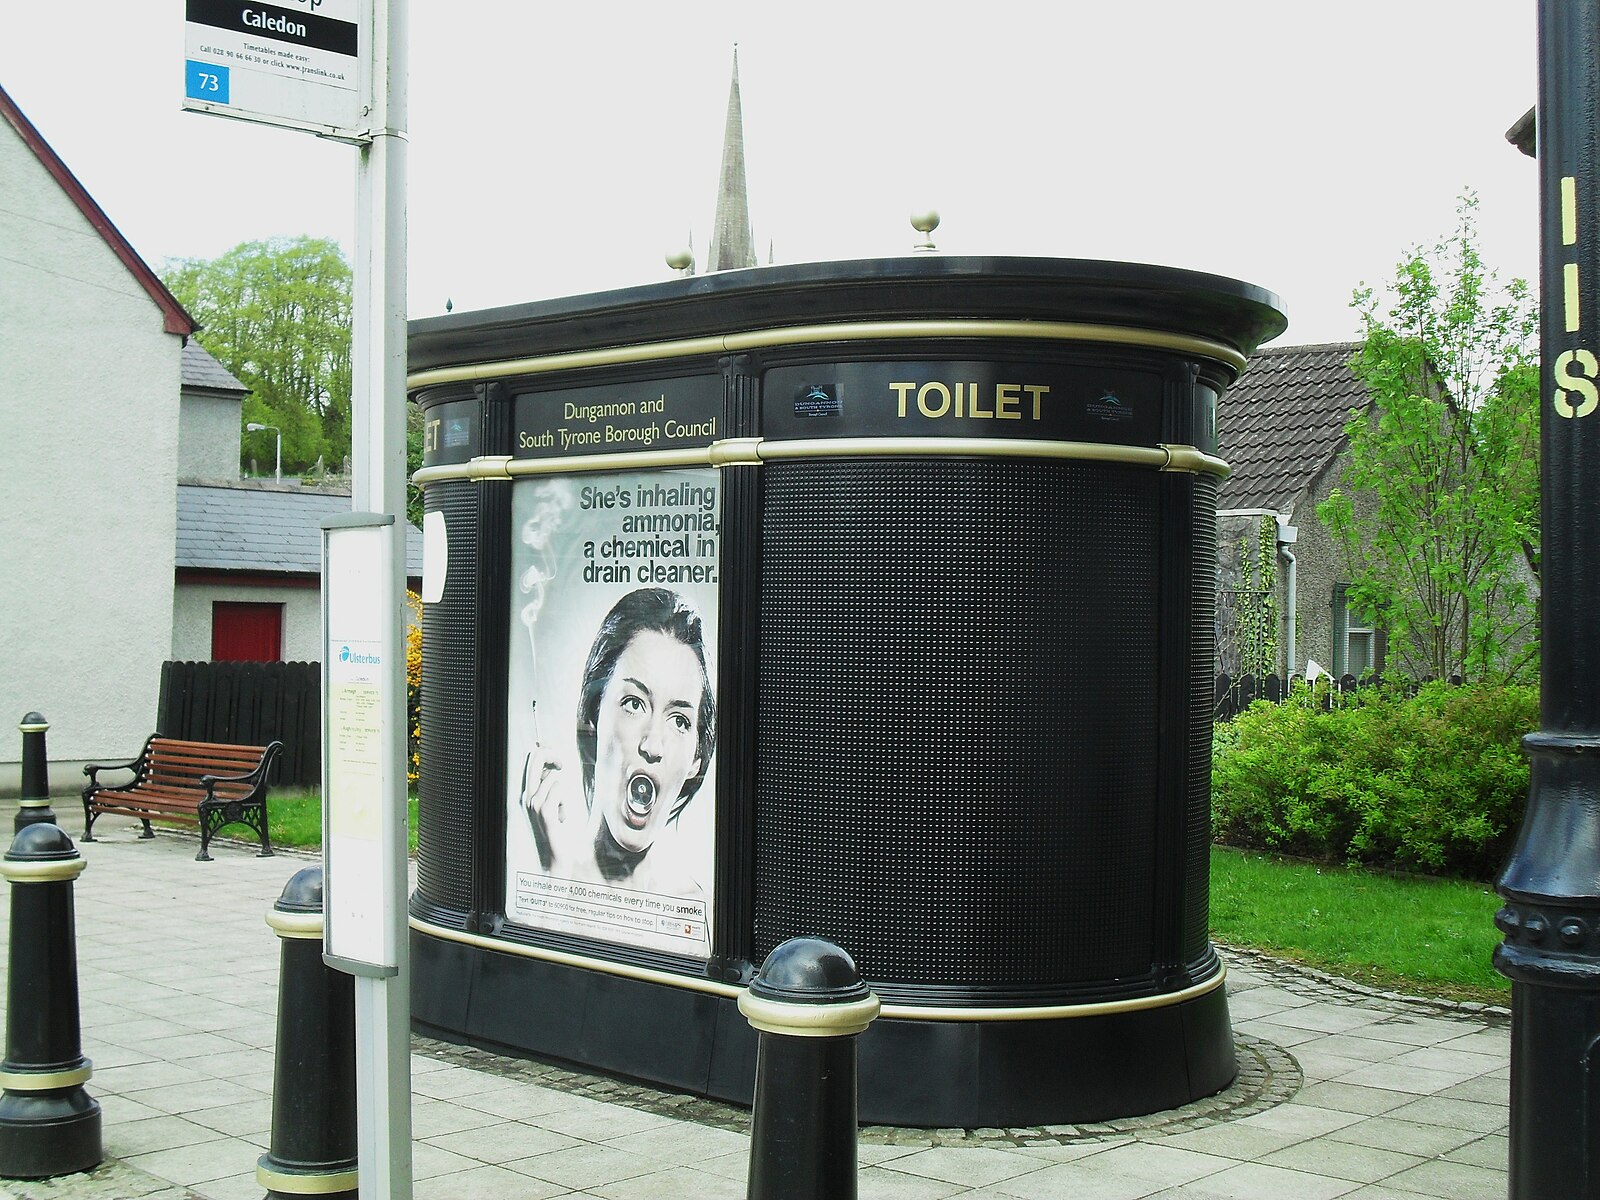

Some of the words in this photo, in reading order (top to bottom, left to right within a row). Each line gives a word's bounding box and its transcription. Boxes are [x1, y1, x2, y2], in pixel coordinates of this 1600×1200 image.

[242, 9, 306, 37] Caledon
[200, 45, 212, 53] Call
[213, 47, 224, 56] 028
[270, 59, 284, 68] click
[286, 63, 345, 80] www.translink.co.uk
[243, 42, 276, 55] Timetables
[278, 50, 294, 59] made
[295, 54, 310, 64] easy:
[199, 73, 219, 92] 73
[564, 402, 636, 423] Dungannon
[640, 394, 664, 414] and
[889, 381, 1050, 420] TOILET
[519, 429, 554, 449] South
[558, 428, 601, 451] Tyrone
[605, 421, 660, 445] Borough
[664, 416, 716, 438] Council
[580, 485, 631, 510] She's
[636, 482, 716, 511] inhaling
[622, 508, 720, 536] ammonia,
[583, 540, 594, 558] a
[600, 534, 689, 559] chemical
[696, 534, 715, 558] in
[583, 560, 631, 583] drain
[637, 560, 718, 584] cleaner.
[349, 652, 381, 664] Ulsterbus
[520, 877, 531, 888] You
[533, 880, 552, 891] inhale
[554, 884, 567, 893] over
[569, 886, 586, 896] 4,000
[588, 890, 622, 903] chemicals
[624, 896, 644, 908] every
[645, 898, 660, 910] time
[662, 903, 674, 912] you
